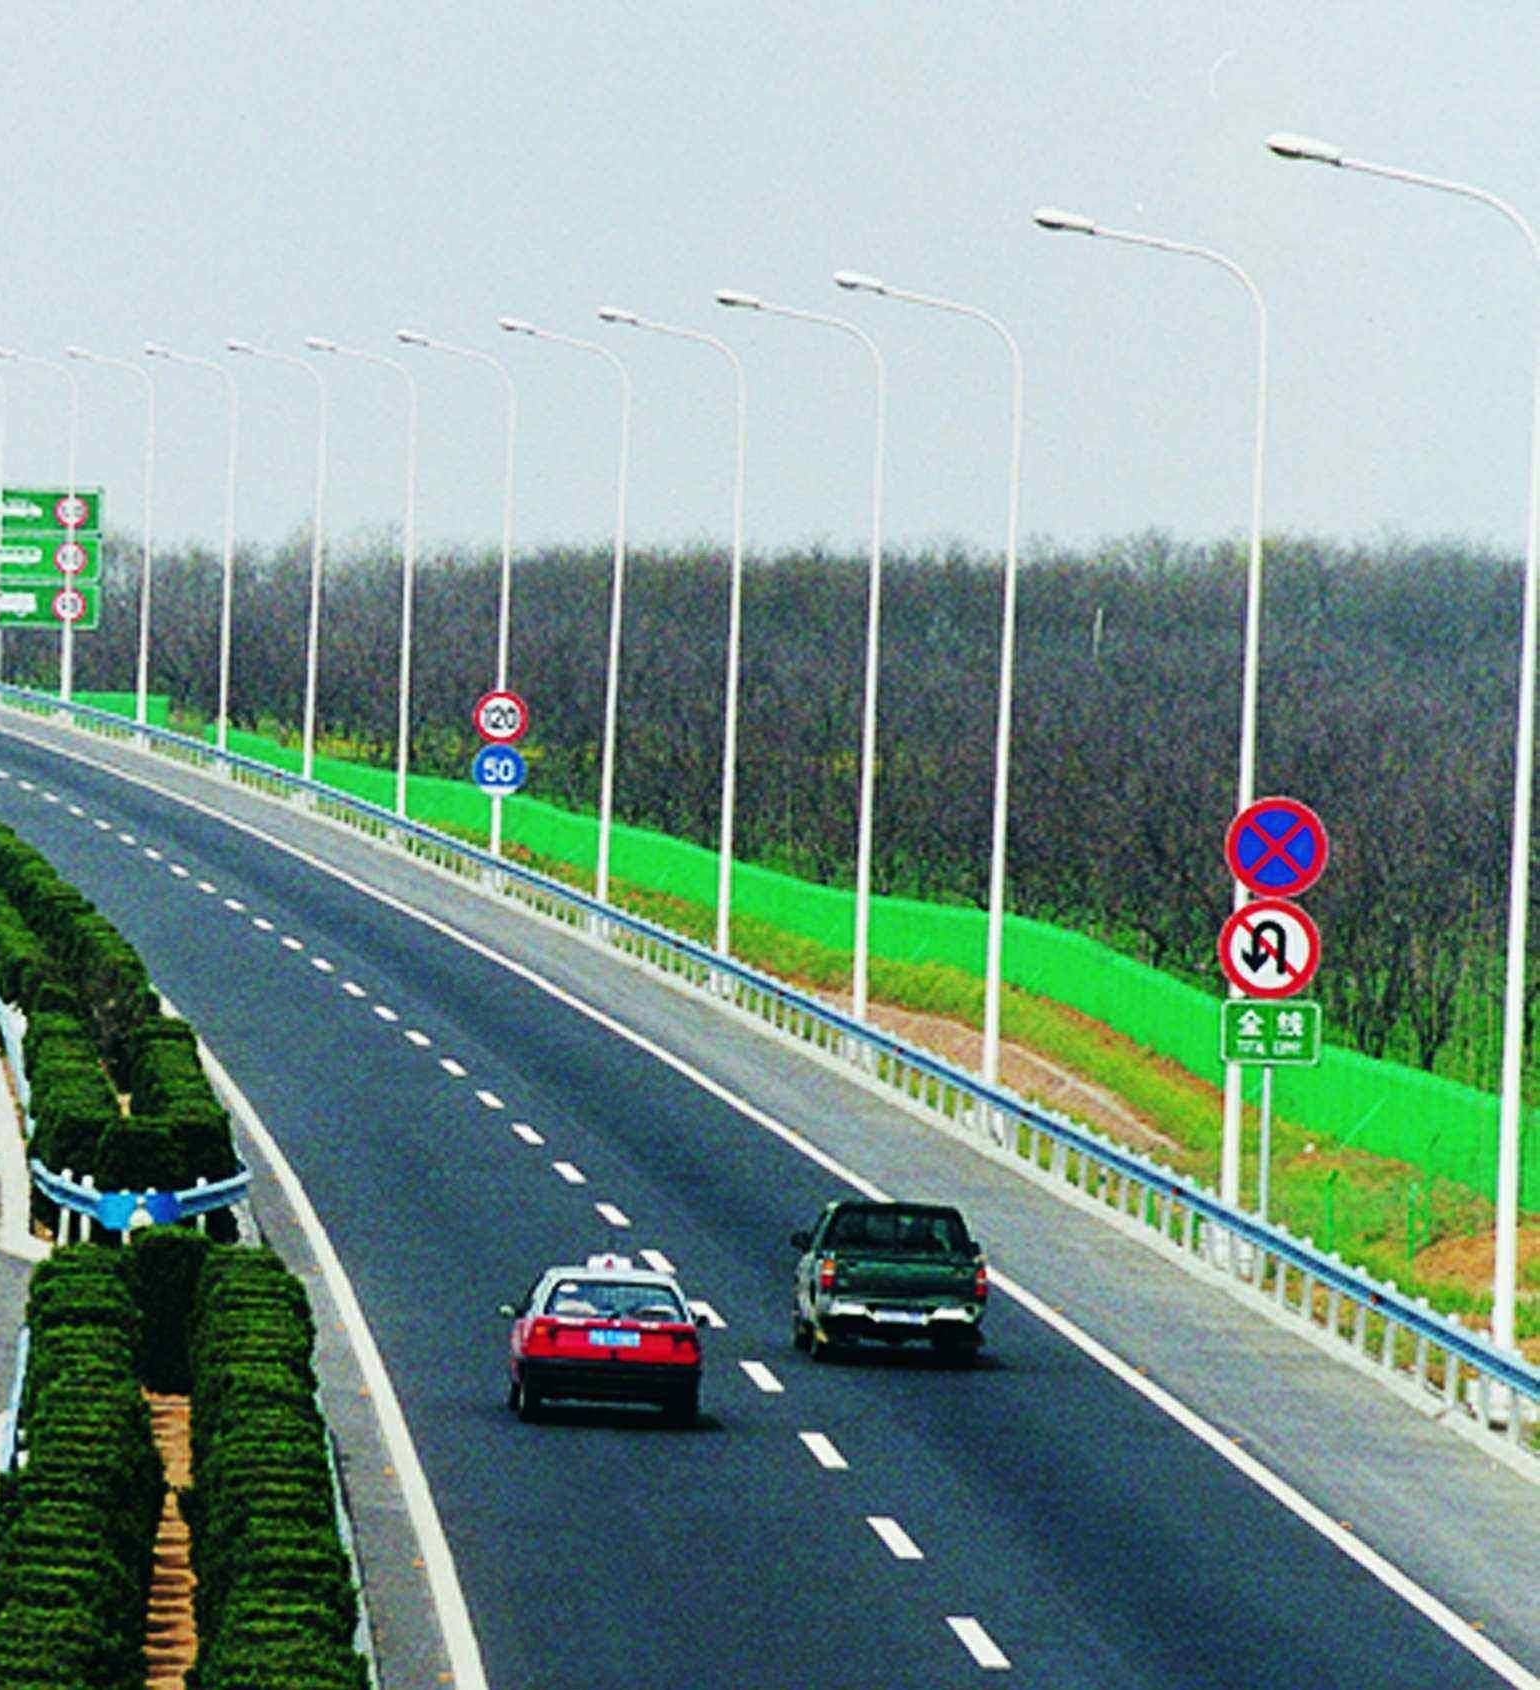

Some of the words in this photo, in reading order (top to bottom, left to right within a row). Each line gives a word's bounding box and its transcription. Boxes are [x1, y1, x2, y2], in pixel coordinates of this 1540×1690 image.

[484, 705, 519, 730] 120
[483, 756, 516, 782] 50
[1237, 1008, 1304, 1037] 全线
